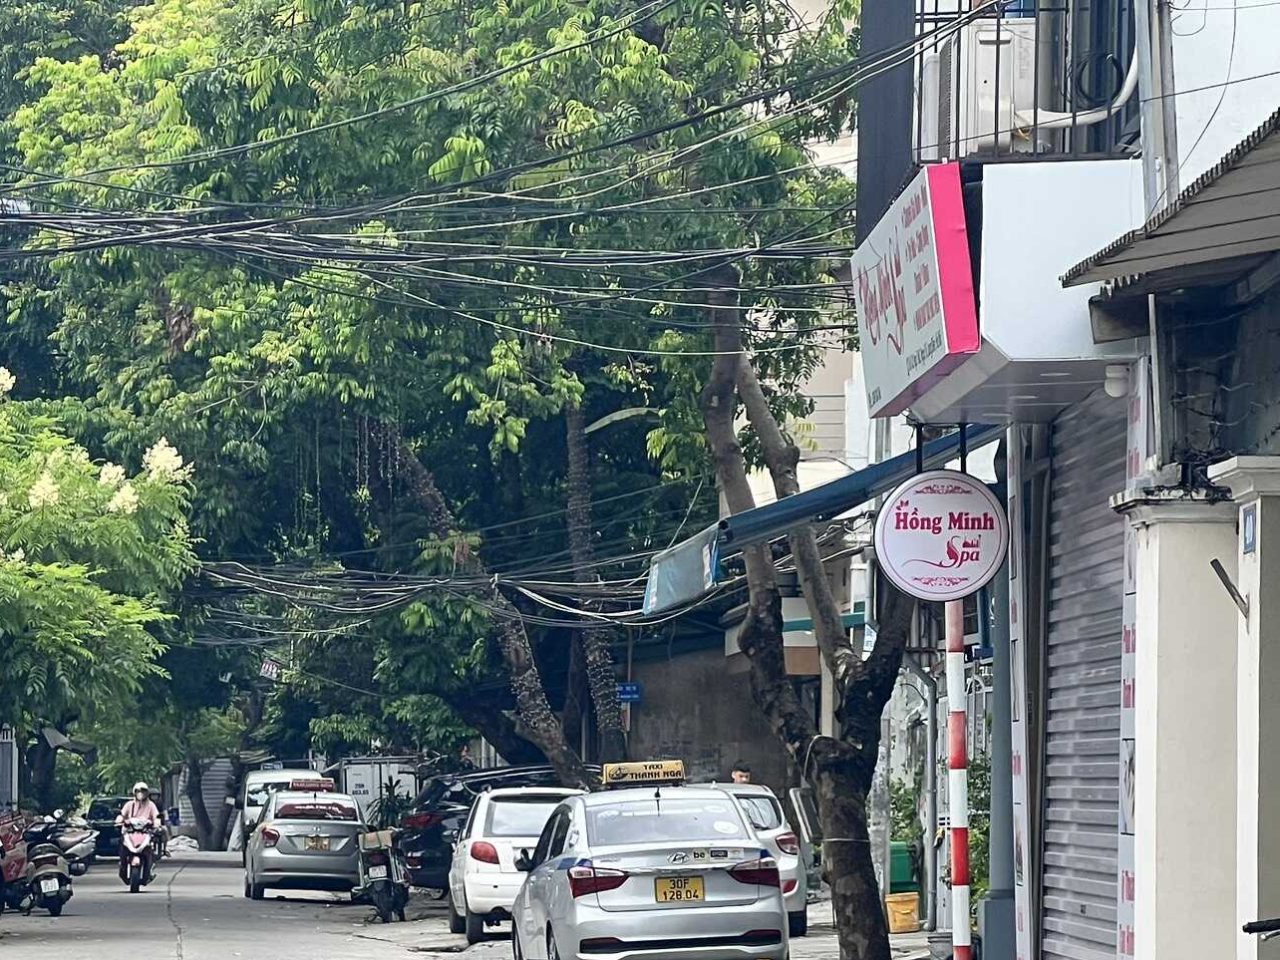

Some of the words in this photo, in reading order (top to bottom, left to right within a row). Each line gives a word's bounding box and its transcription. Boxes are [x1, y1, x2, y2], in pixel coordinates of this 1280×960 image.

[895, 507, 942, 535] Hồng
[948, 512, 995, 530] Minh
[946, 535, 980, 568] Spa
[670, 879, 690, 889] 30F
[662, 889, 699, 901] 128.04
